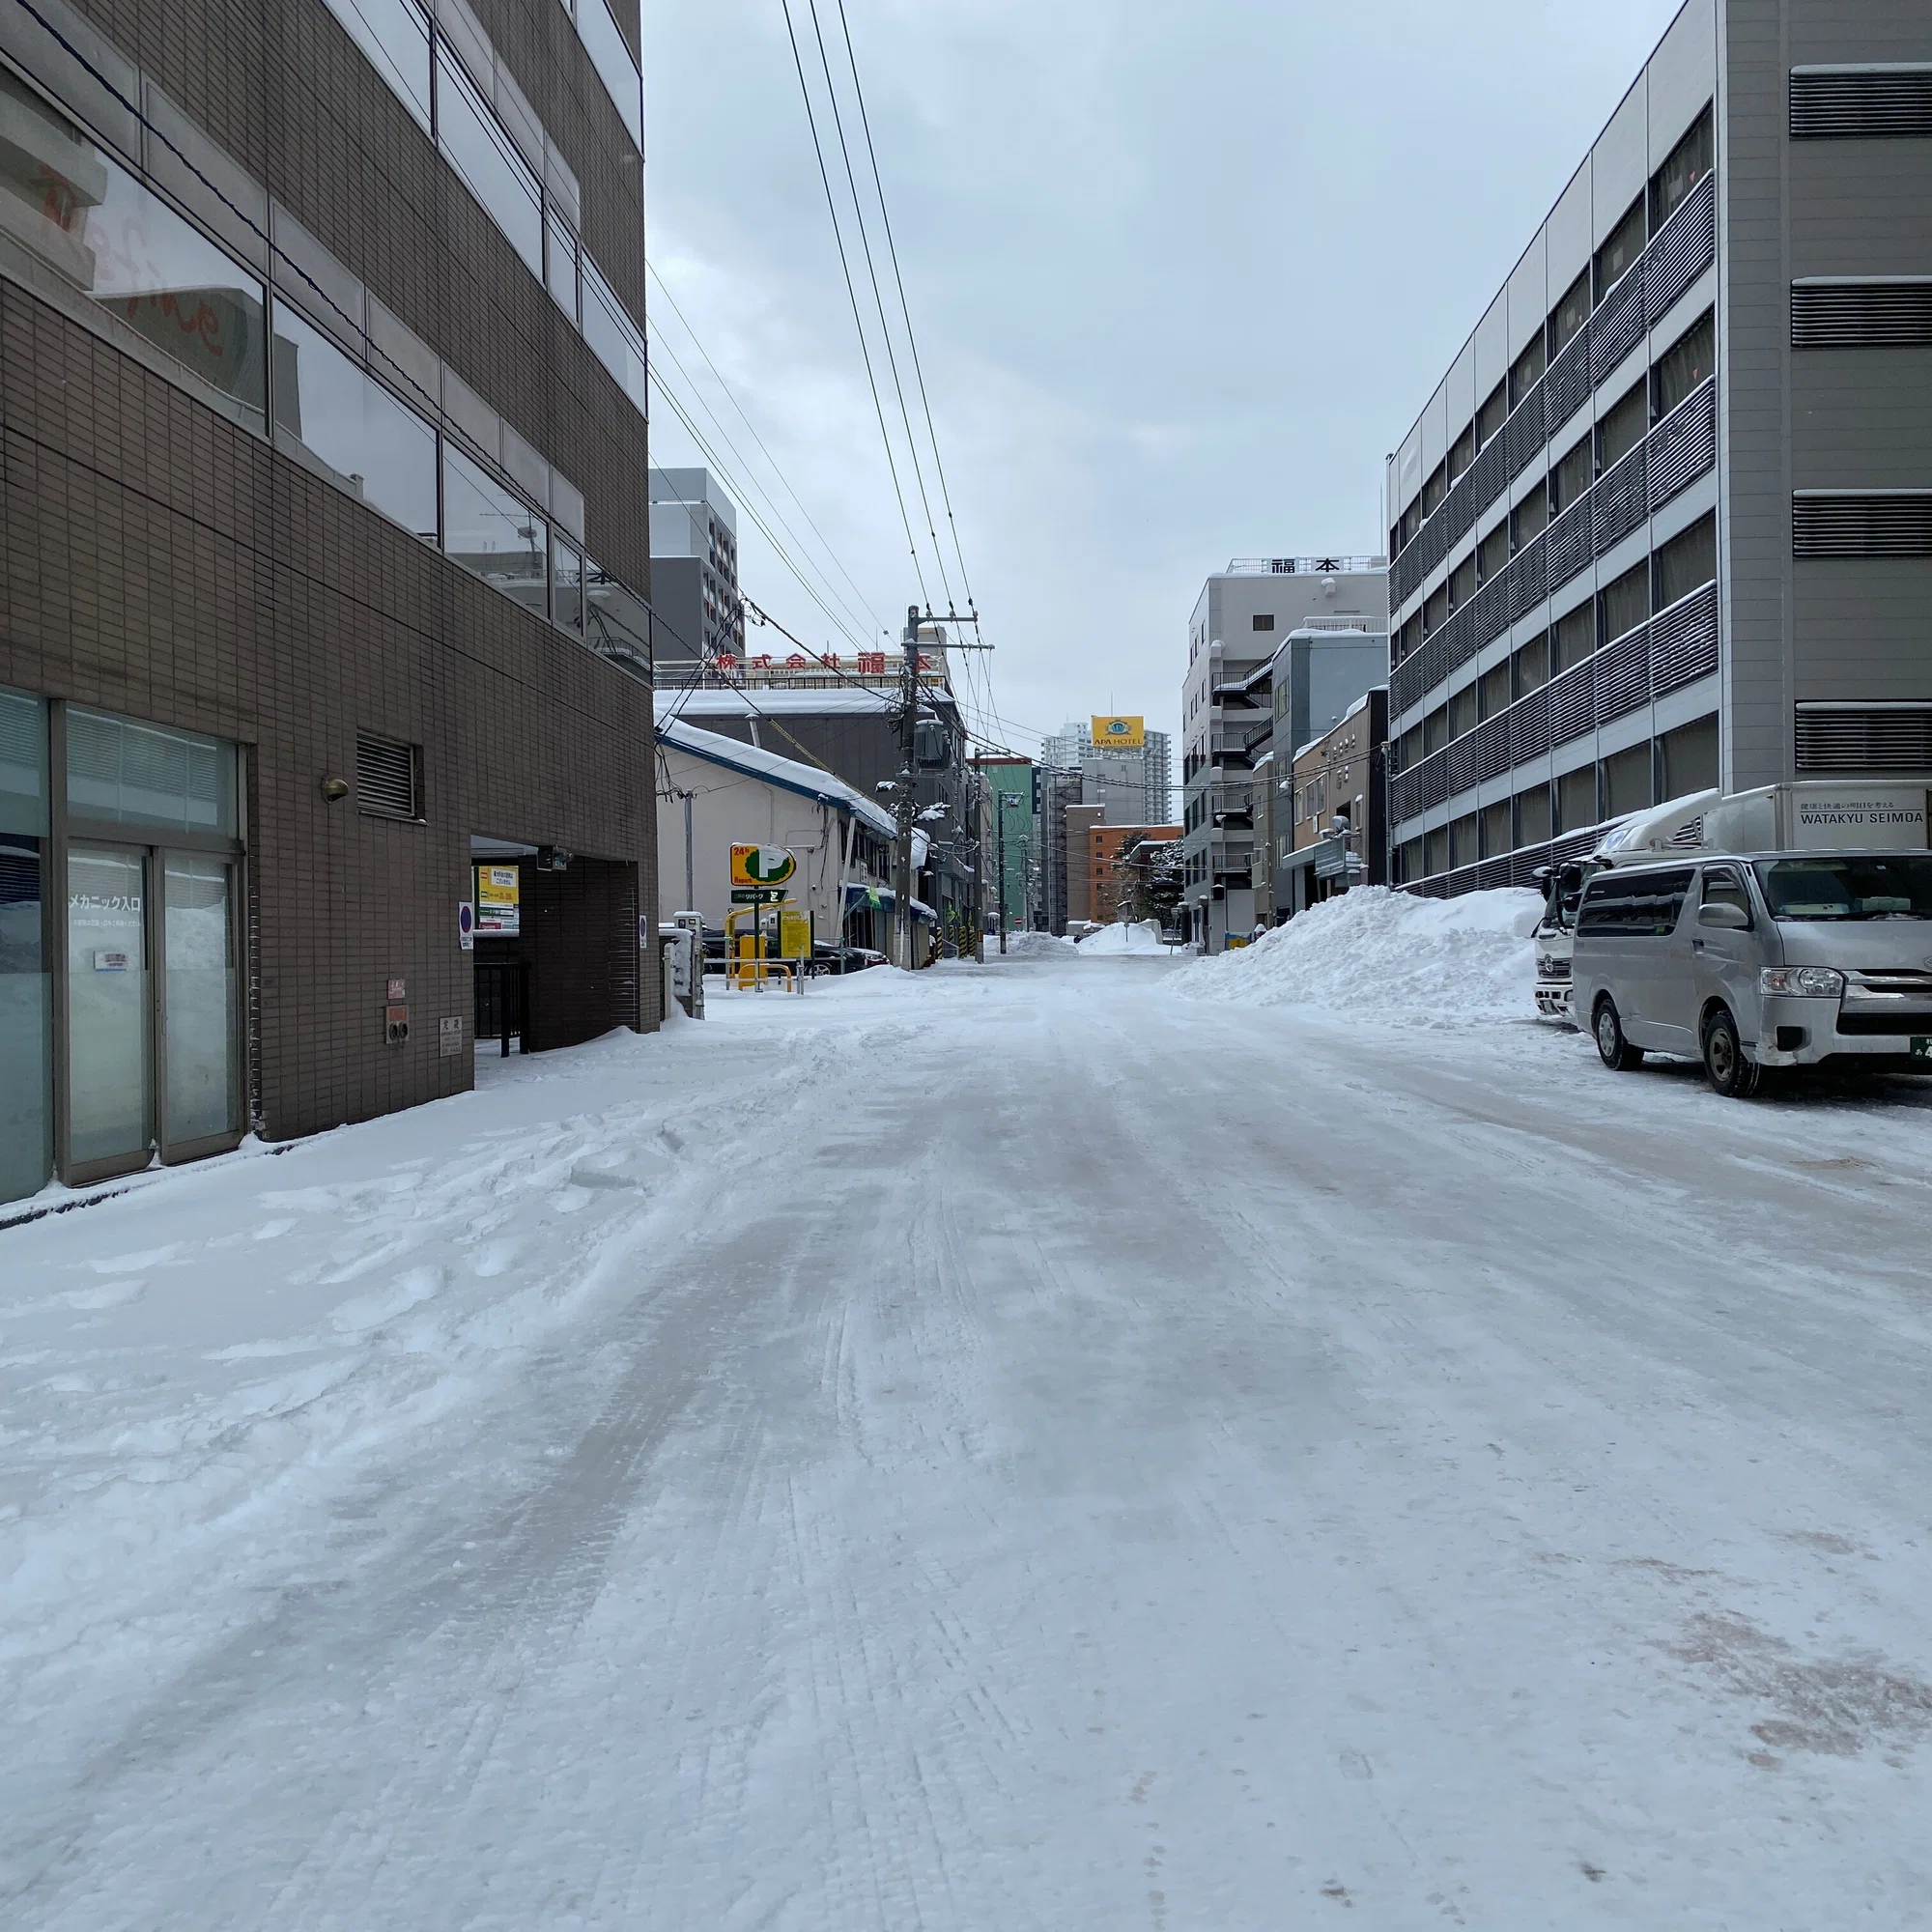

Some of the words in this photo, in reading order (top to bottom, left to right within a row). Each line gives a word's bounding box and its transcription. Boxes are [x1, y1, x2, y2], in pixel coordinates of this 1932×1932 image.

[1271, 557, 1340, 573] 福本
[1801, 813, 1863, 824] WATAKYU
[1869, 812, 1923, 823] SEIMOA
[70, 894, 141, 912] メカニック入口
